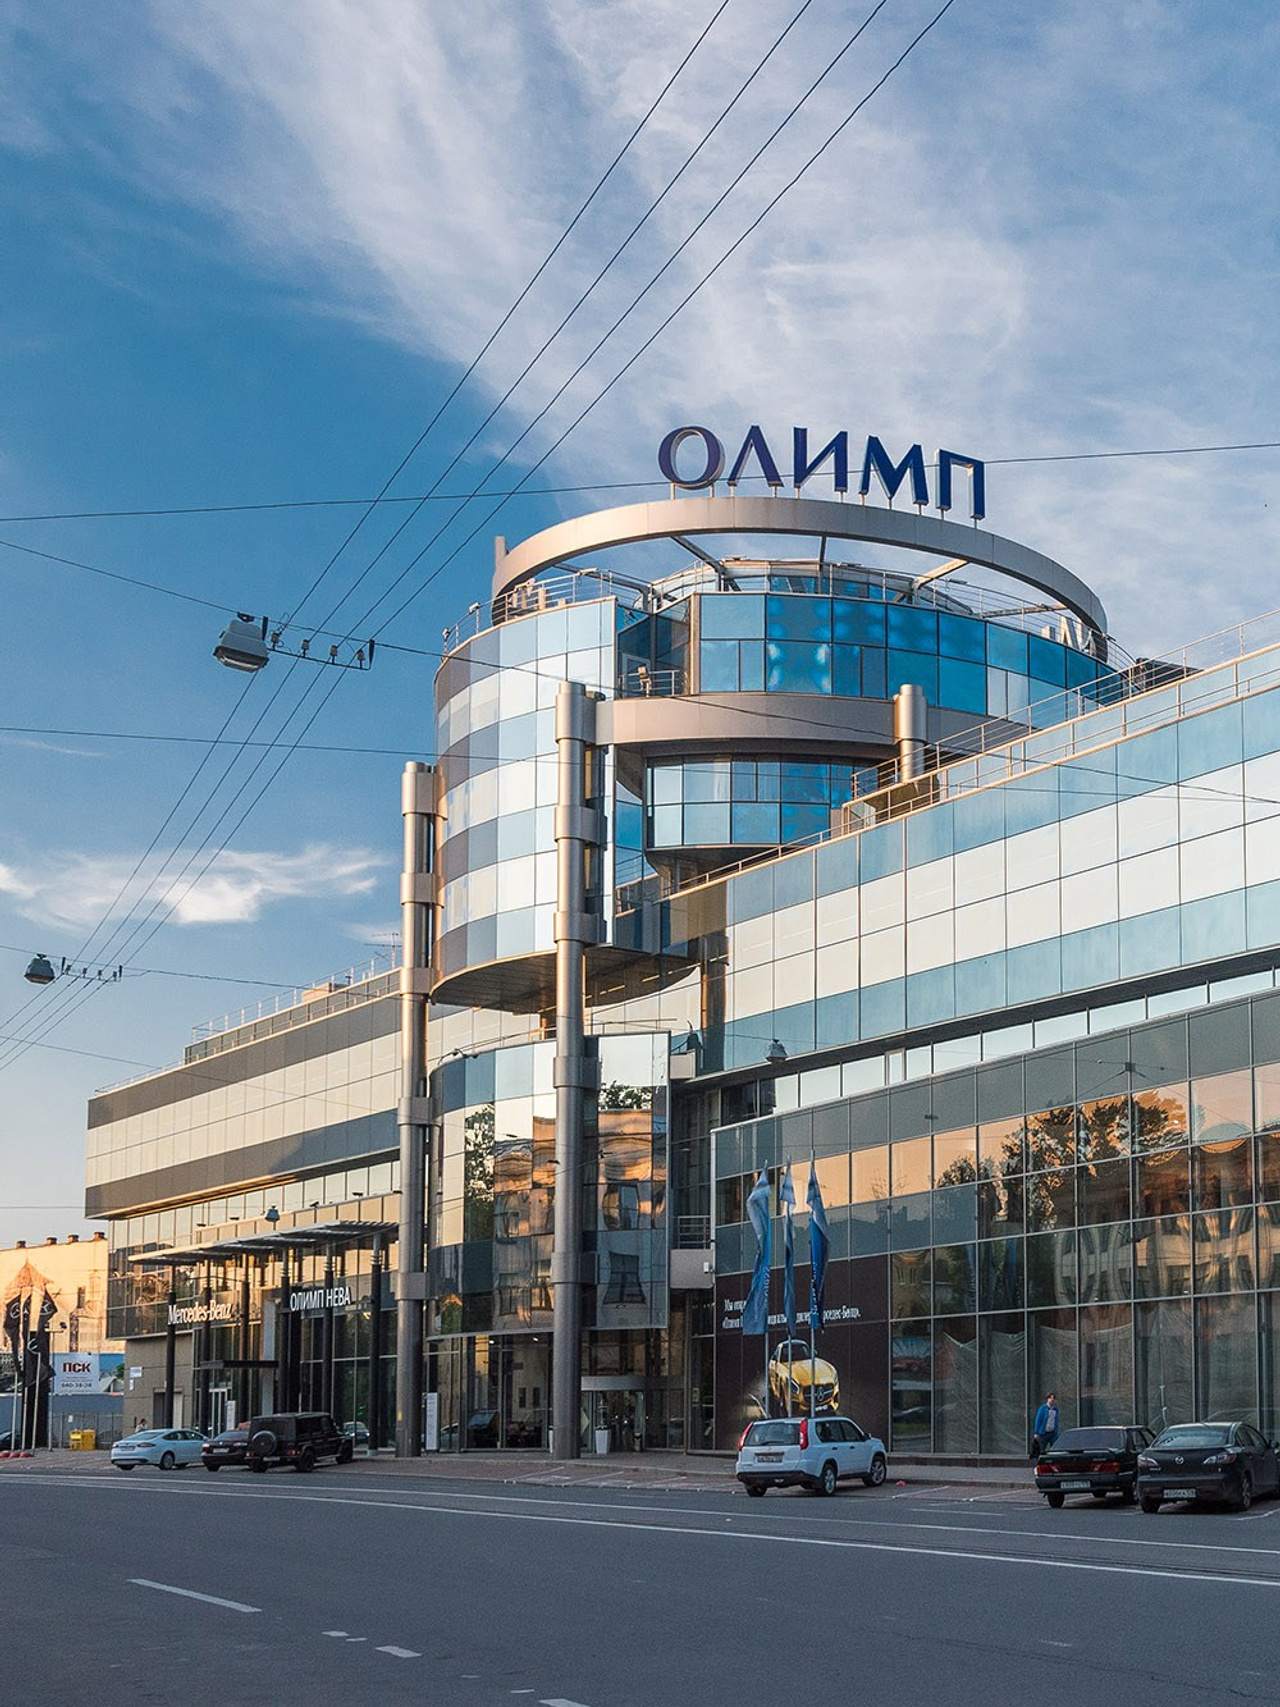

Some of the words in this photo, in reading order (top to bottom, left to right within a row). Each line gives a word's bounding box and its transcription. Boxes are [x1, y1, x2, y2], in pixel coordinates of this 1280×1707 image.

[657, 425, 986, 520] ОЛИМП
[290, 1289, 324, 1312] ОЛИМП
[326, 1286, 352, 1308] НЕВА
[168, 1300, 233, 1326] Mercedes-Benz
[62, 1362, 91, 1373] ПСК
